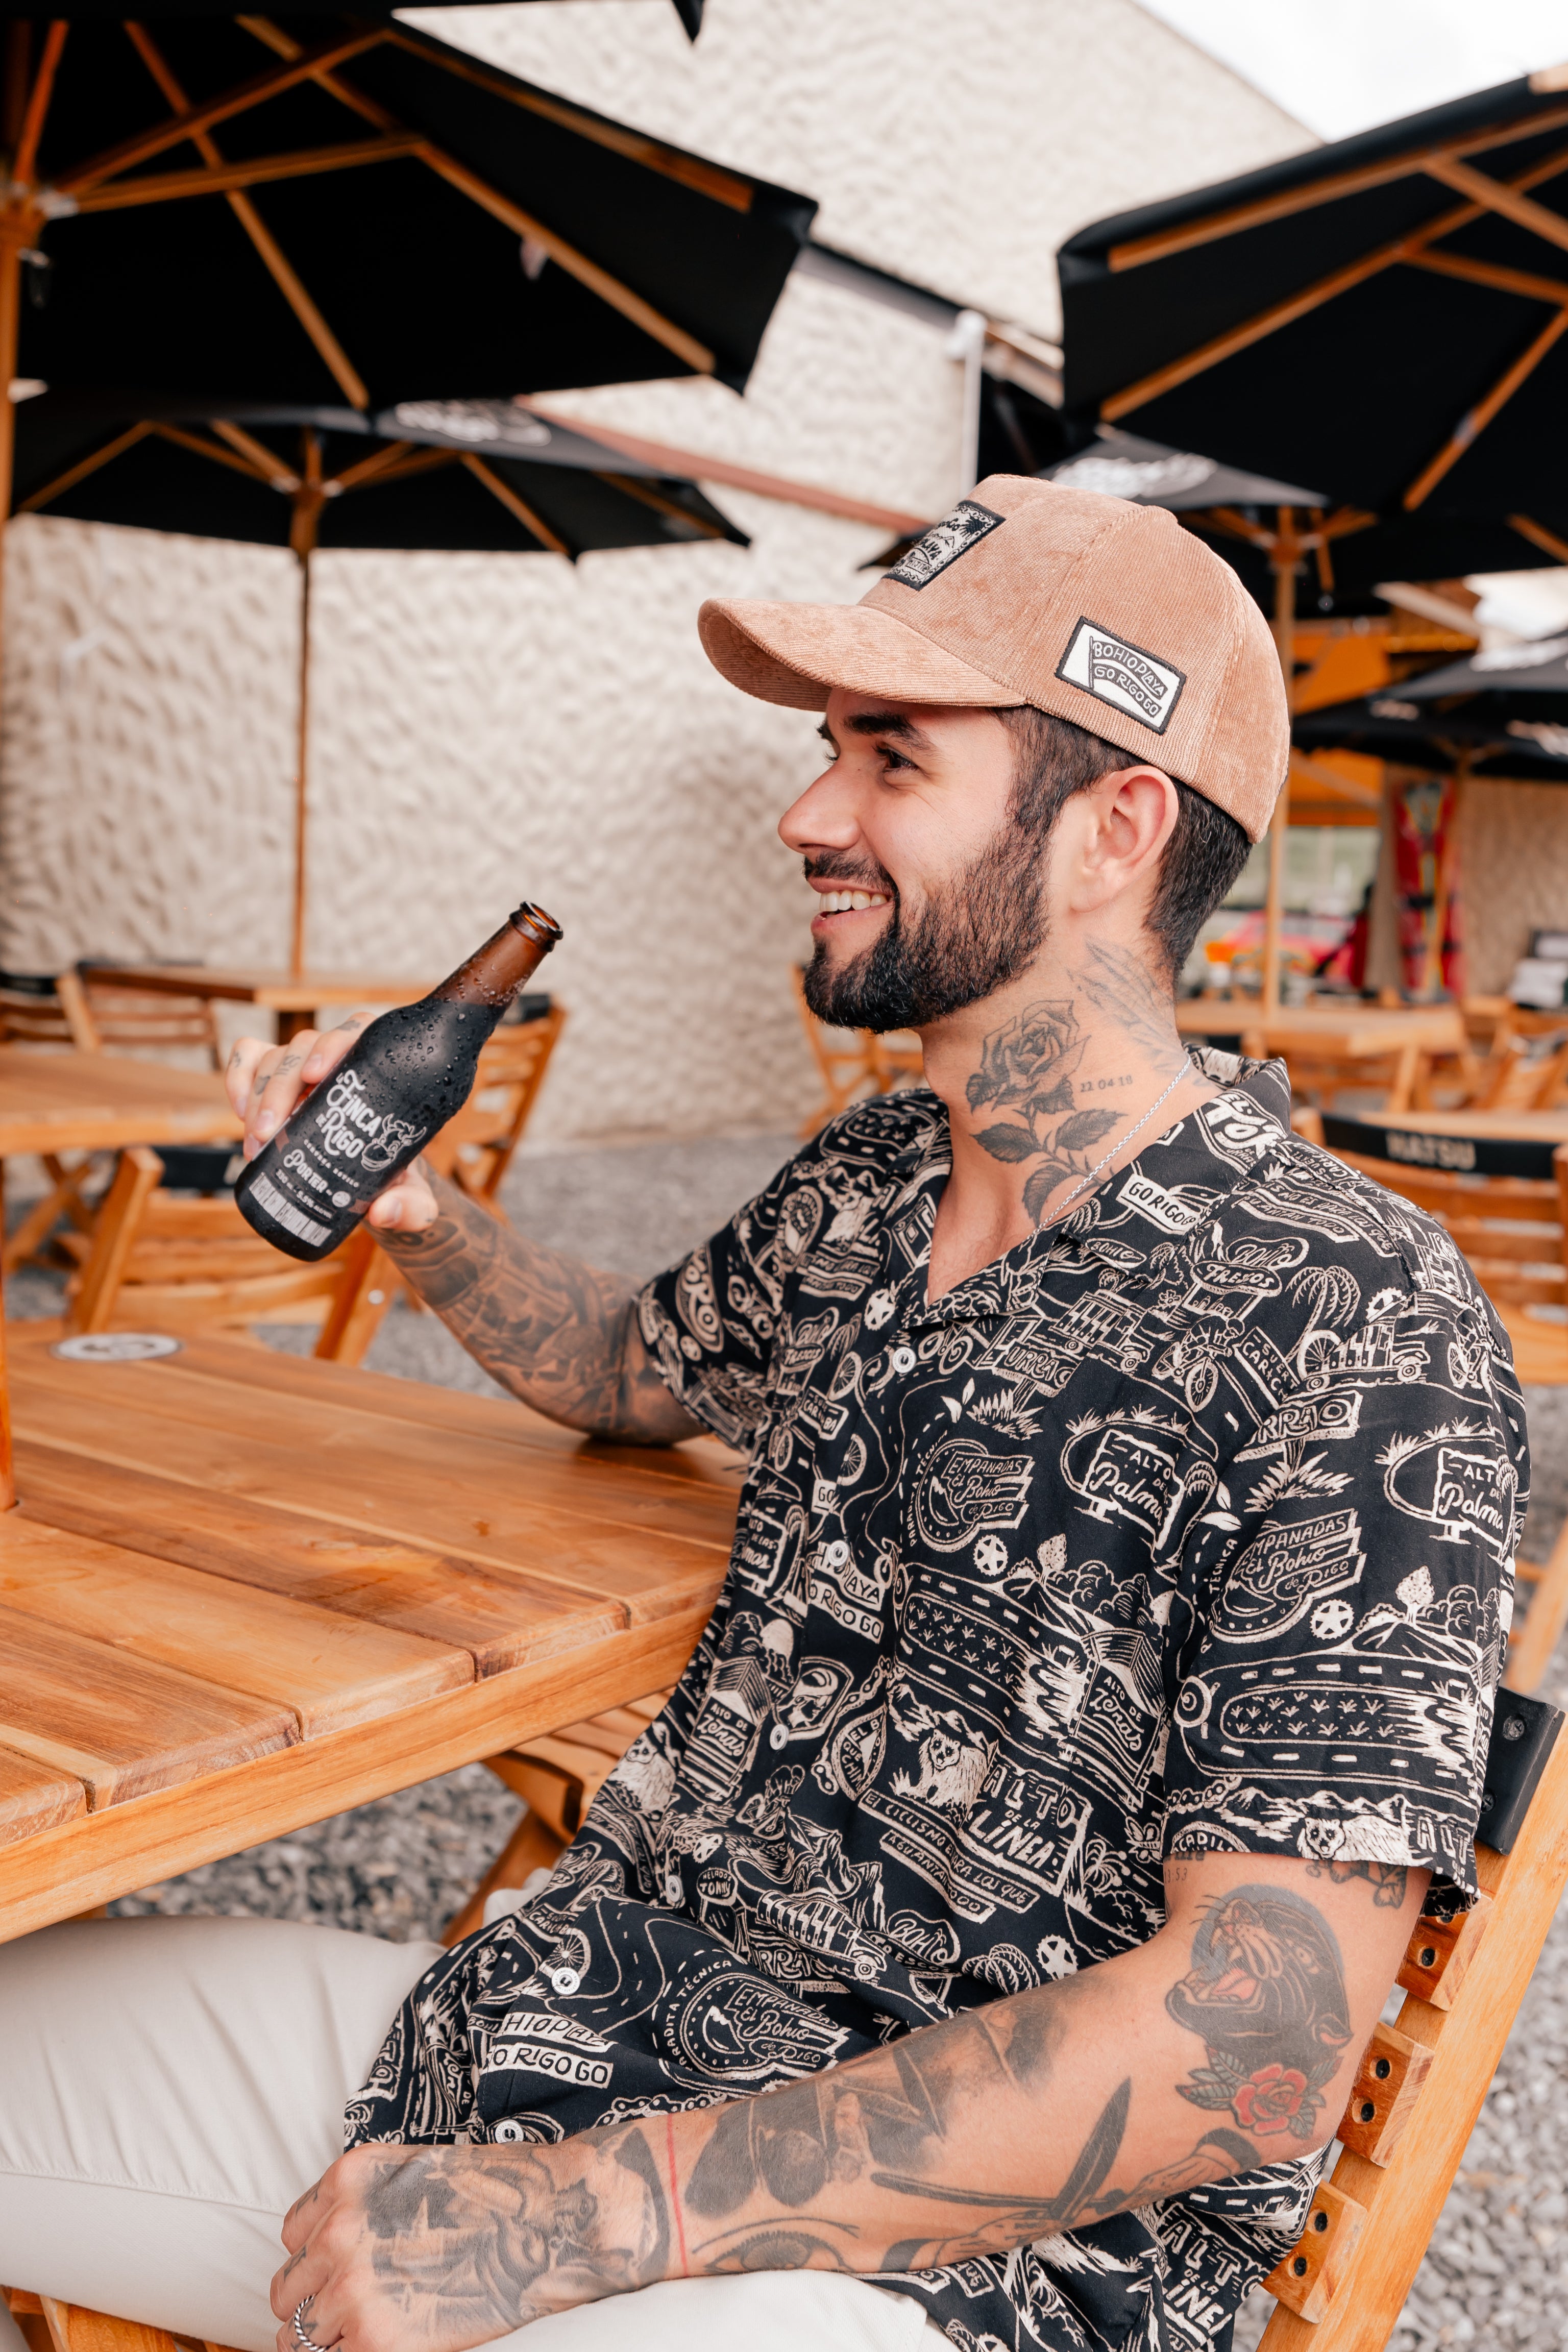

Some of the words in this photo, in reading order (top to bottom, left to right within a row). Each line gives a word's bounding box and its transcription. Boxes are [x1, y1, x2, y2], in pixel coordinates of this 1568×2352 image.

[1094, 666, 1115, 679] GO
[1117, 673, 1145, 701] RIGO
[1143, 699, 1159, 716] GO
[1098, 1078, 1115, 1090] 04
[275, 1168, 288, 1184] 330
[283, 1149, 328, 1194] PORTER
[1129, 1182, 1153, 1200] GO
[1147, 1195, 1185, 1223] RIGO
[1308, 1217, 1345, 1234] TODO
[948, 1457, 1022, 1475] EMPANADAS
[1129, 1450, 1171, 1480] ALTO
[820, 1588, 856, 1625] RIGO
[859, 1615, 882, 1639] GO
[1129, 1706, 1142, 1722] DE
[736, 1719, 749, 1731] DE
[850, 1727, 868, 1742] EL
[843, 1741, 863, 1762] QUE
[983, 1763, 1076, 1829] ALTO
[1004, 1809, 1022, 1823] DE
[1023, 1818, 1041, 1830] LA
[885, 1803, 946, 1847] CICLISMO
[973, 1872, 1001, 1891] LOS
[1001, 1884, 1028, 1904] QUE
[702, 1870, 732, 1882] HELADOS
[512, 2047, 572, 2076] RIGO
[574, 2060, 608, 2085] GO
[1184, 2269, 1200, 2283] DE
[1200, 2281, 1219, 2295] LA
